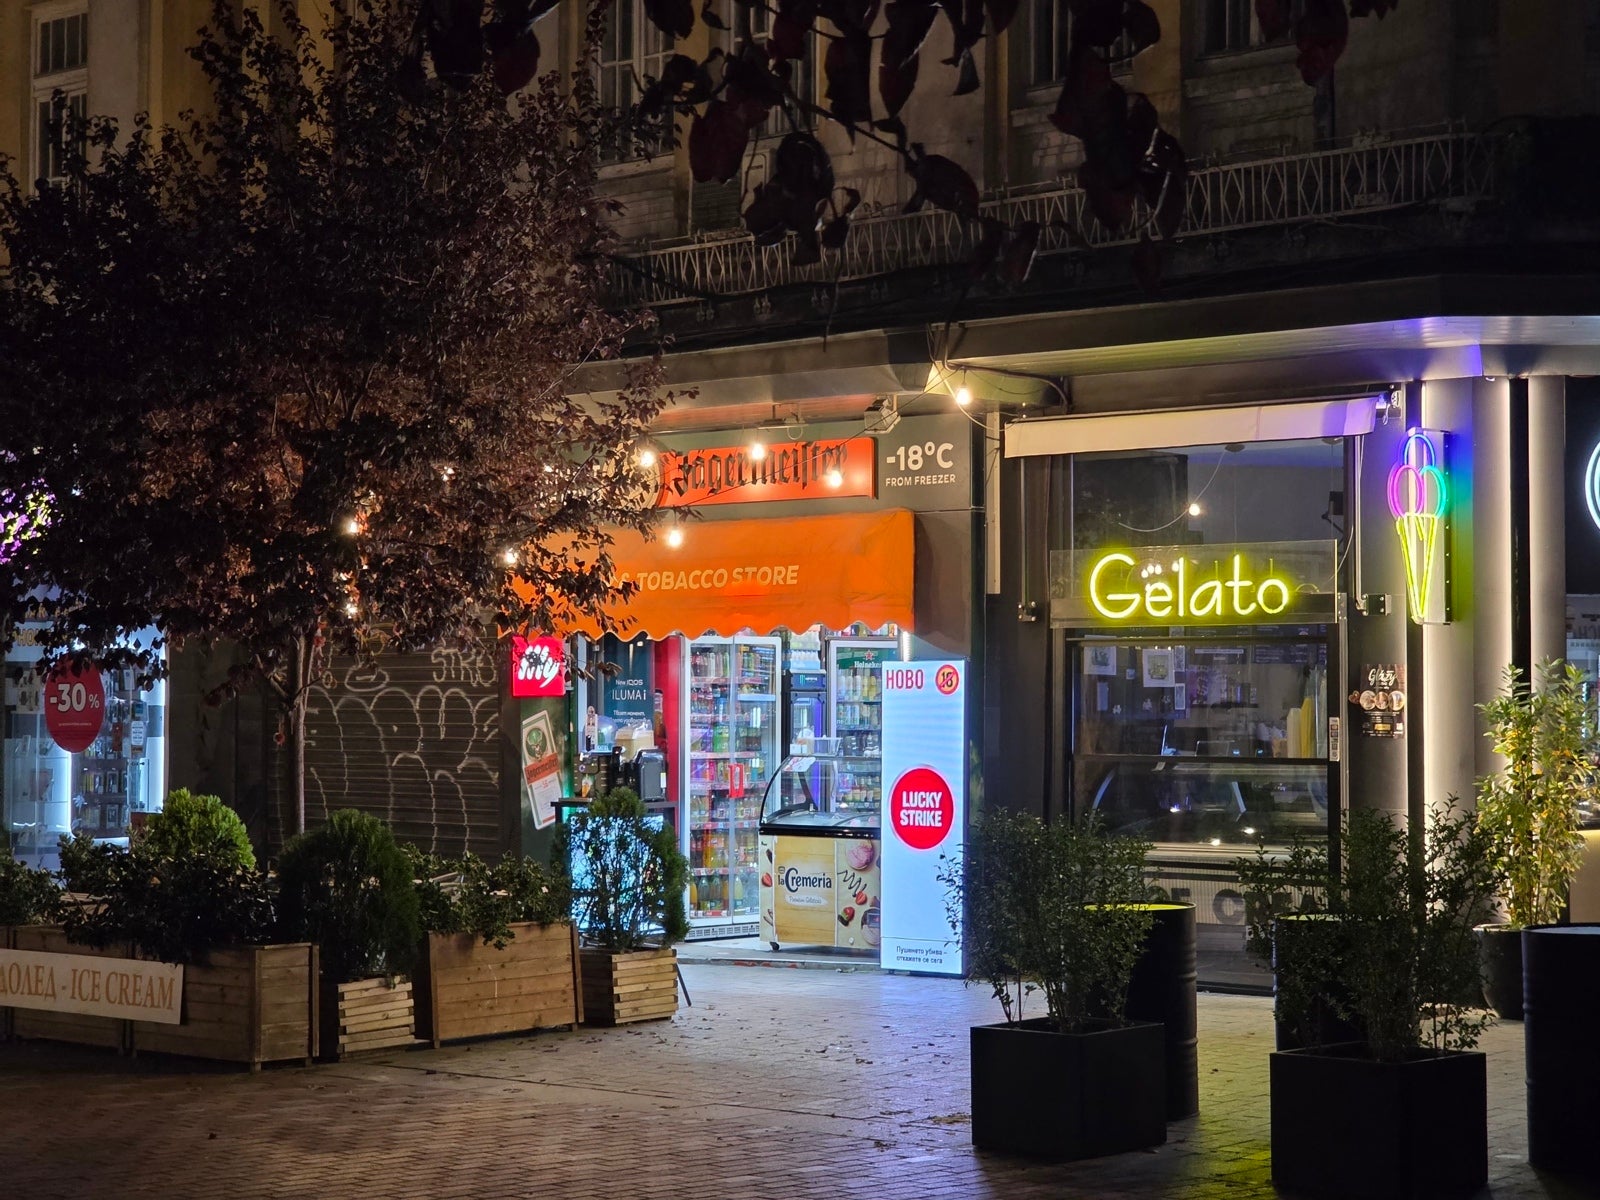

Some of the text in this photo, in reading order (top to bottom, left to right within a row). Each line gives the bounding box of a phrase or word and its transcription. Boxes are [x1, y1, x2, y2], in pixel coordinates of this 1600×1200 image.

[885, 473, 957, 488] FROM FREEZER
[637, 567, 729, 592] TOBACCO
[729, 564, 800, 587] STORE
[1088, 552, 1291, 620] Gelato
[626, 678, 644, 687] IQOS
[611, 689, 642, 701] ILUMA
[901, 790, 943, 809] LUCKY
[899, 809, 943, 828] STRIKE
[777, 867, 833, 893] la Cremeria
[70, 967, 102, 1002] ICE
[105, 970, 176, 1011] CREAM
